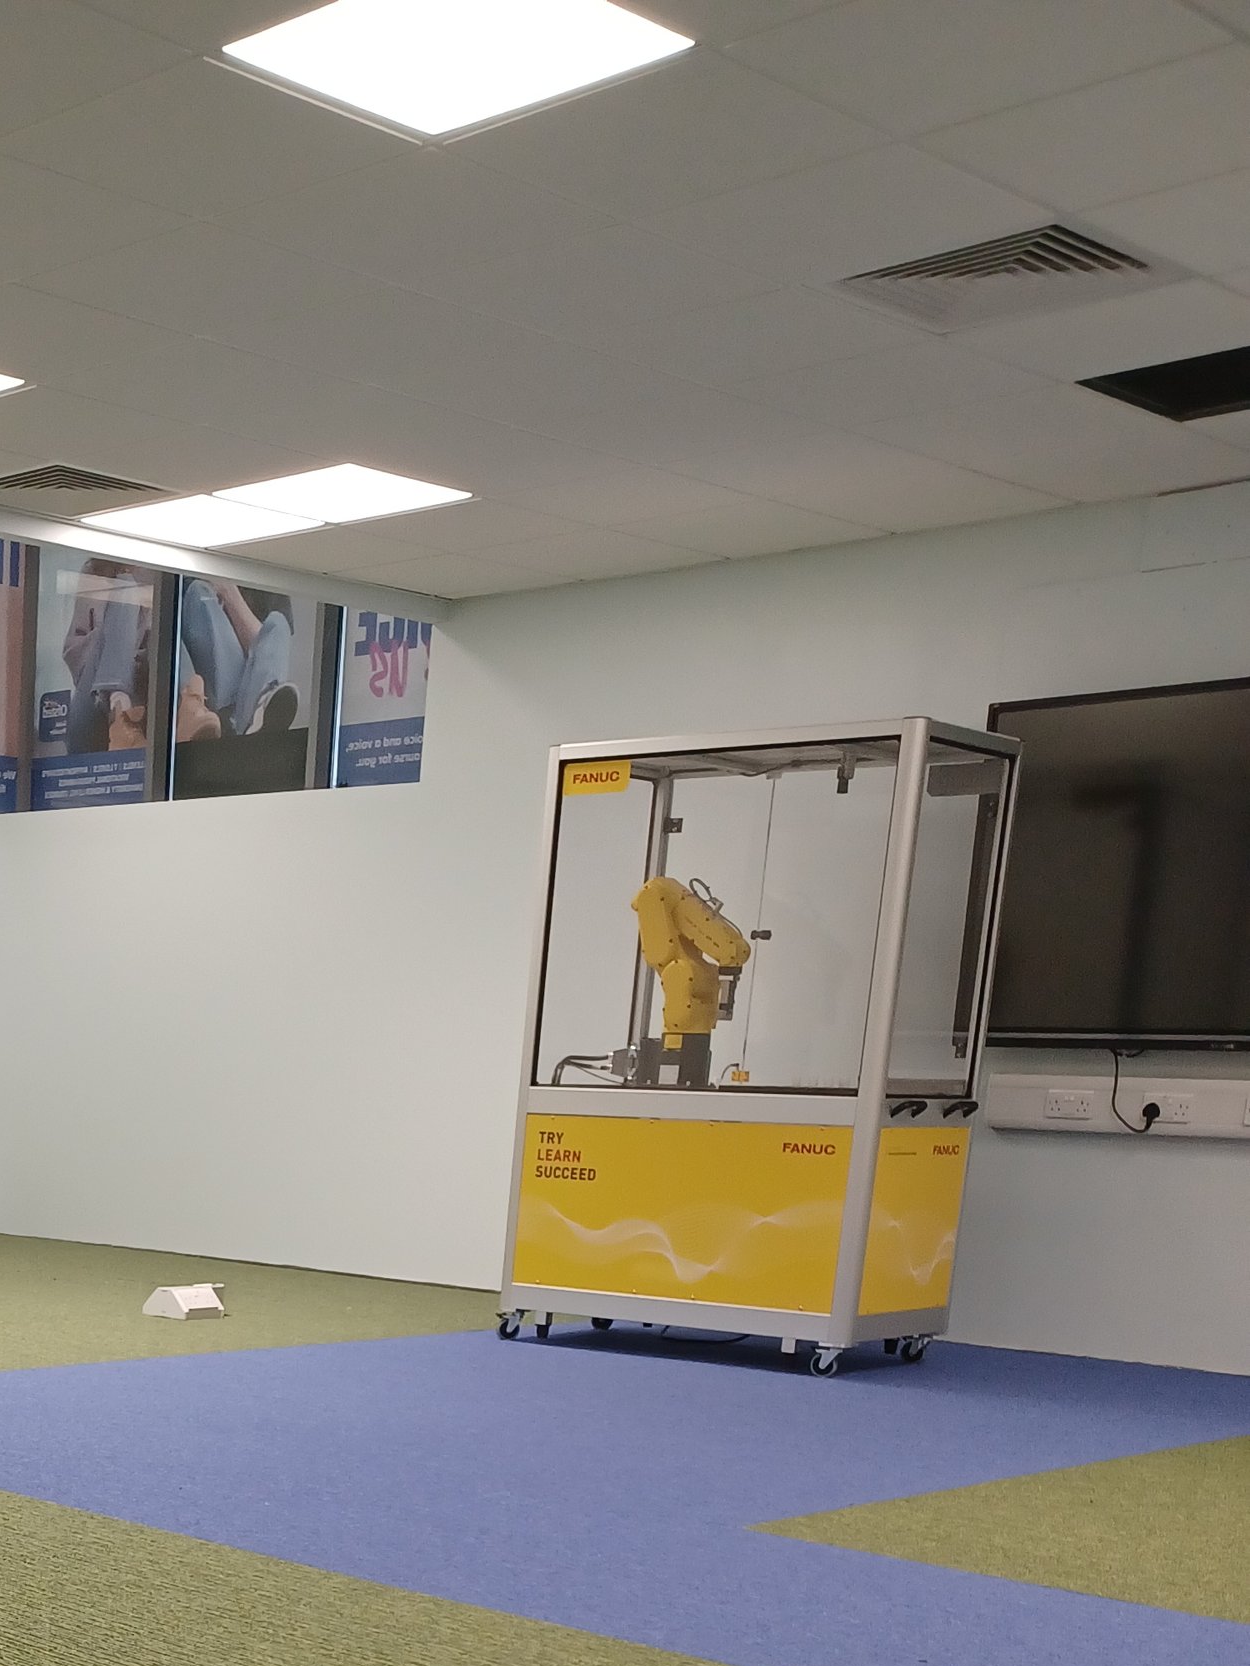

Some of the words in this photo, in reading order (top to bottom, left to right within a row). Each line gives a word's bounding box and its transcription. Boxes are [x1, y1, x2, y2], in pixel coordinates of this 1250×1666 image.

[572, 771, 620, 784] FANUC
[539, 1131, 564, 1144] TRY
[782, 1142, 836, 1155] FANUC
[932, 1144, 960, 1156] FANUC
[537, 1149, 581, 1163] LEARN
[535, 1165, 597, 1181] SUCCEED
